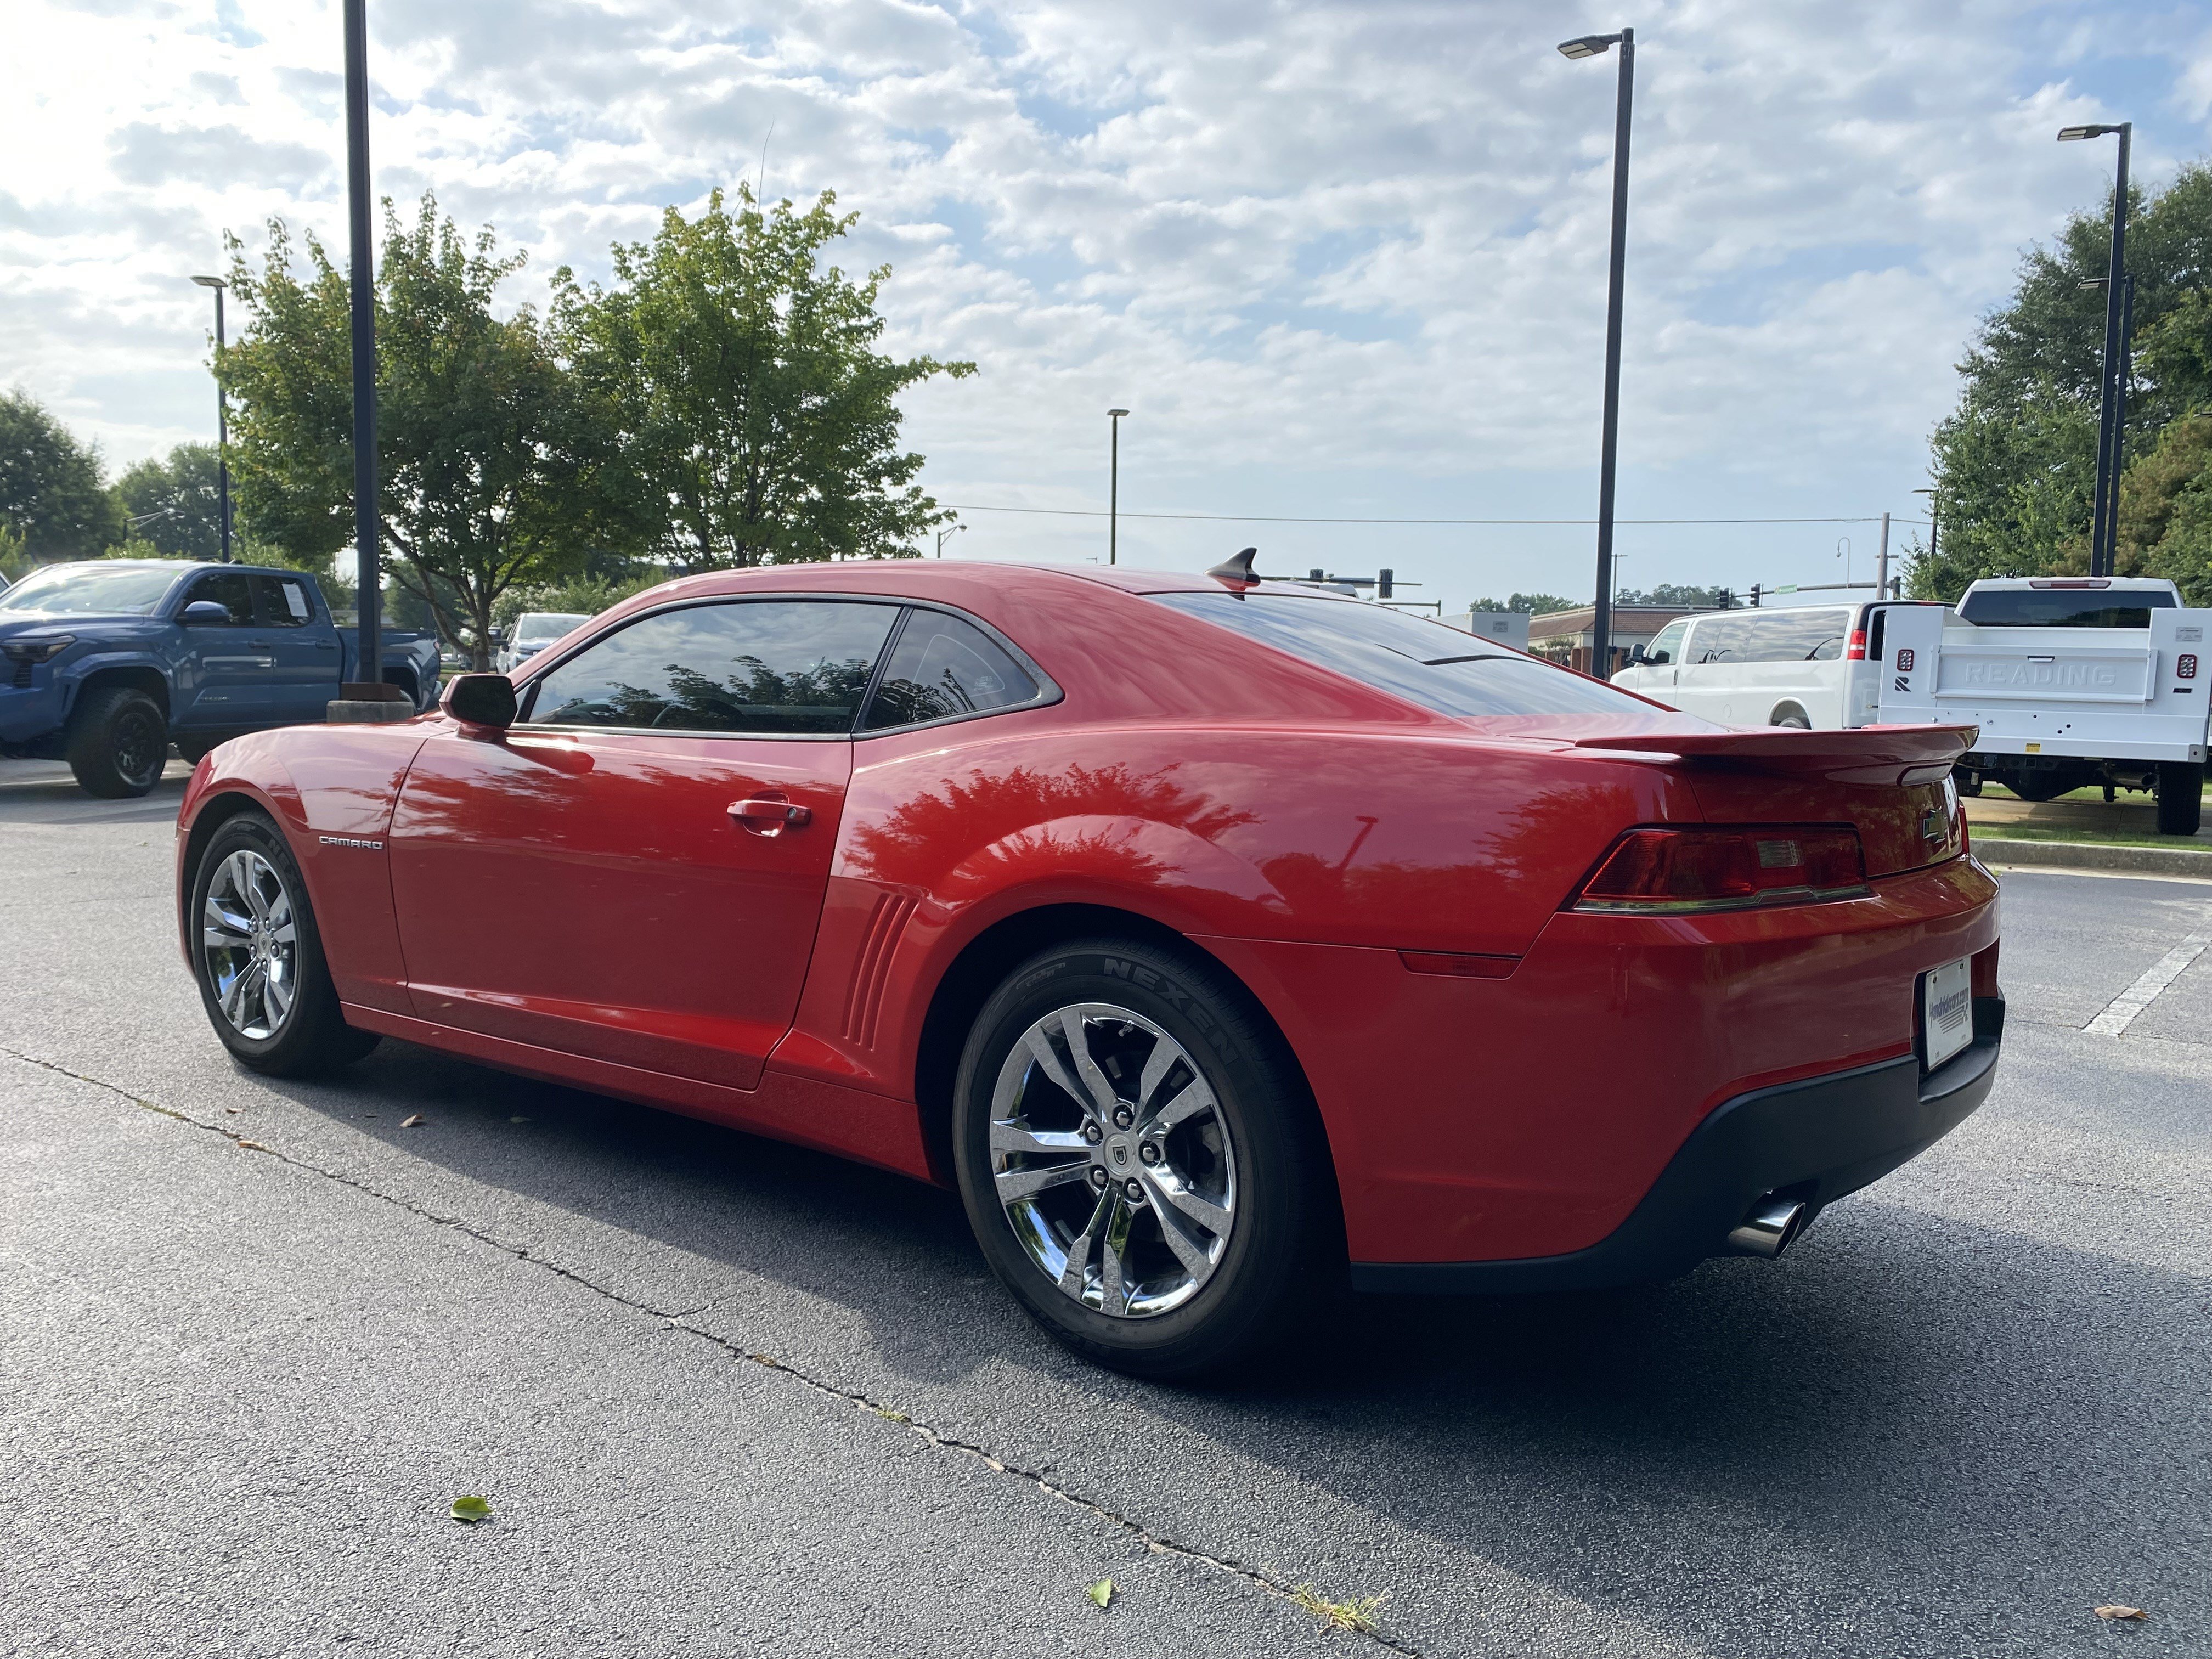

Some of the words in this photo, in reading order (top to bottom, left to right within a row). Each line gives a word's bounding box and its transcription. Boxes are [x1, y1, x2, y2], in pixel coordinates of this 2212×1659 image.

[1966, 663, 2117, 686] READING
[319, 836, 383, 850] CAMARO
[1103, 958, 1239, 1065] NEXEN
